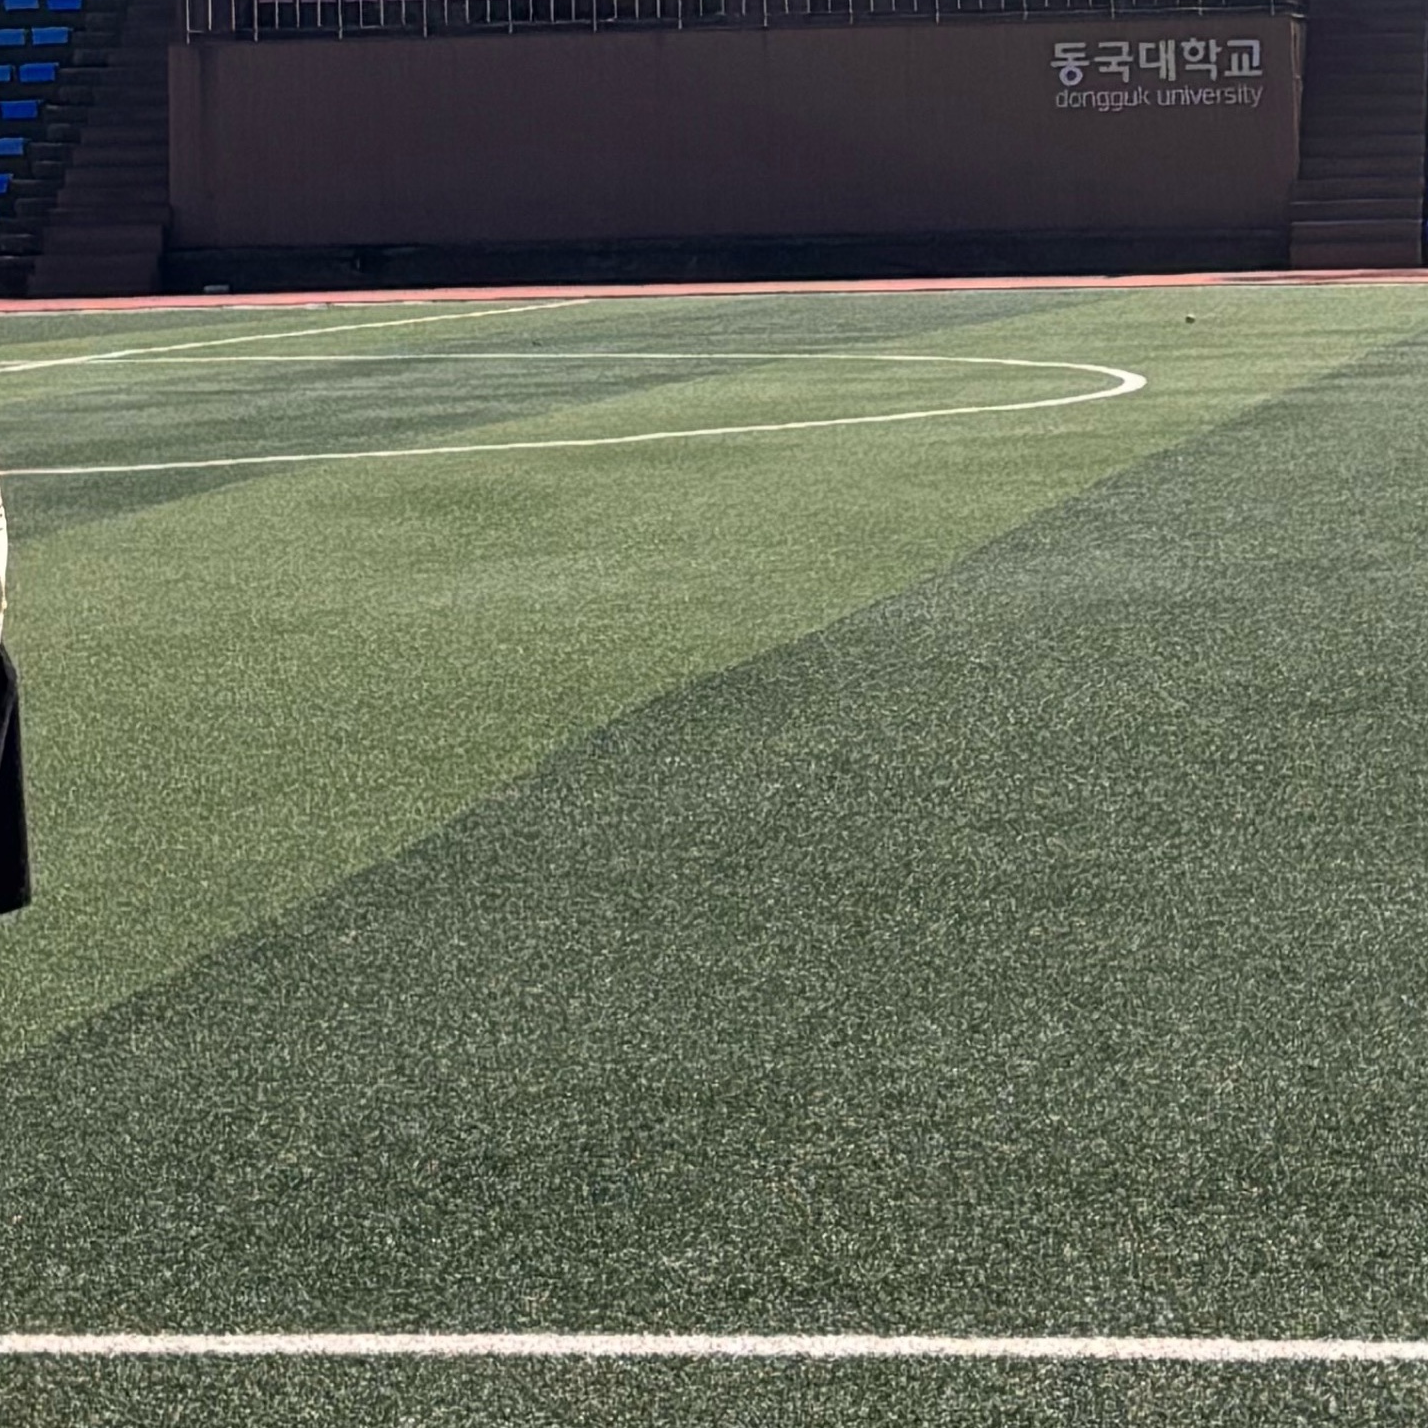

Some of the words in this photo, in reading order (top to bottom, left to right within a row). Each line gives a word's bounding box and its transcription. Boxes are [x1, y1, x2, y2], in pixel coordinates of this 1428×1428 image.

[1049, 37, 1264, 87] 동국대학교
[1055, 86, 1151, 112] dongguk
[1156, 85, 1264, 108] university
